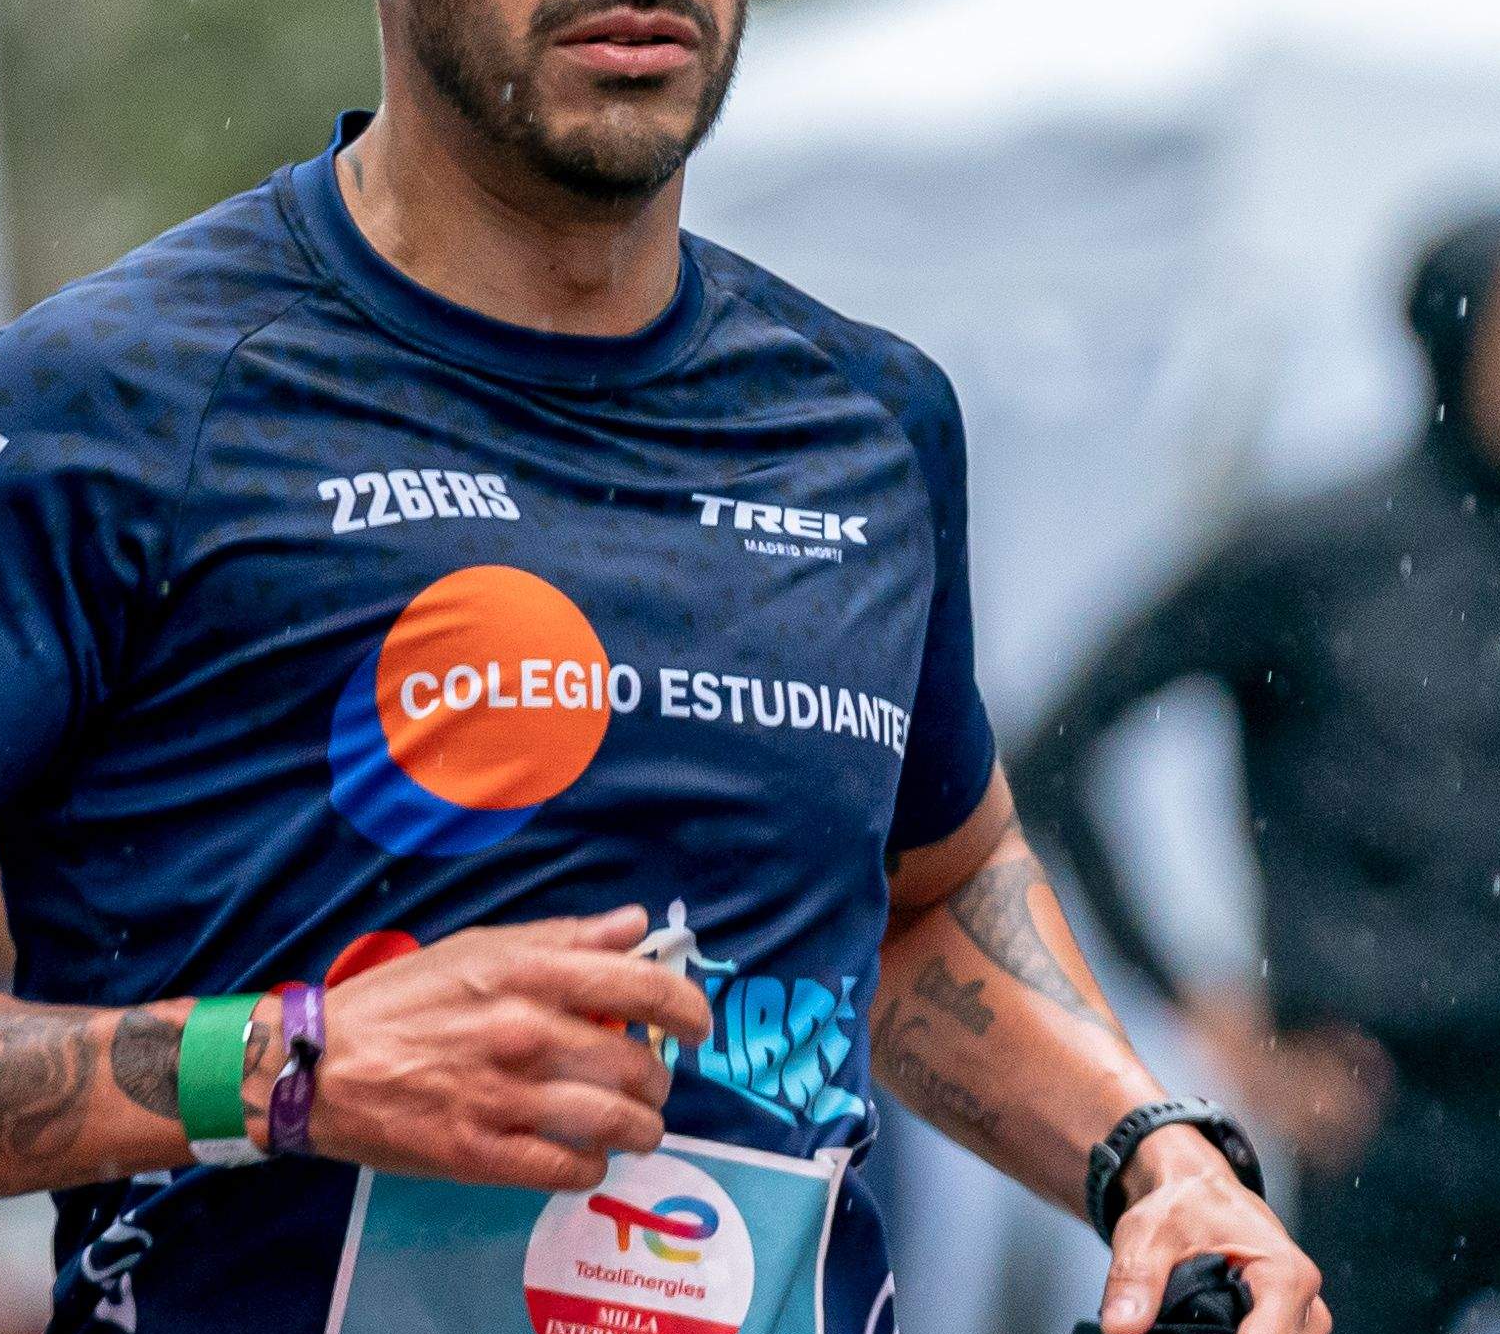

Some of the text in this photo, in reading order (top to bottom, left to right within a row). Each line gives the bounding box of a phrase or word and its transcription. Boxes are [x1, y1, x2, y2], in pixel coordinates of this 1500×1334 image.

[317, 468, 521, 535] 226ERS
[691, 492, 868, 546] TREK
[743, 538, 801, 557] MADRID
[400, 658, 642, 721] COLEGIO
[575, 1259, 707, 1300] TotalEnergies
[598, 1306, 659, 1334] MILLA
